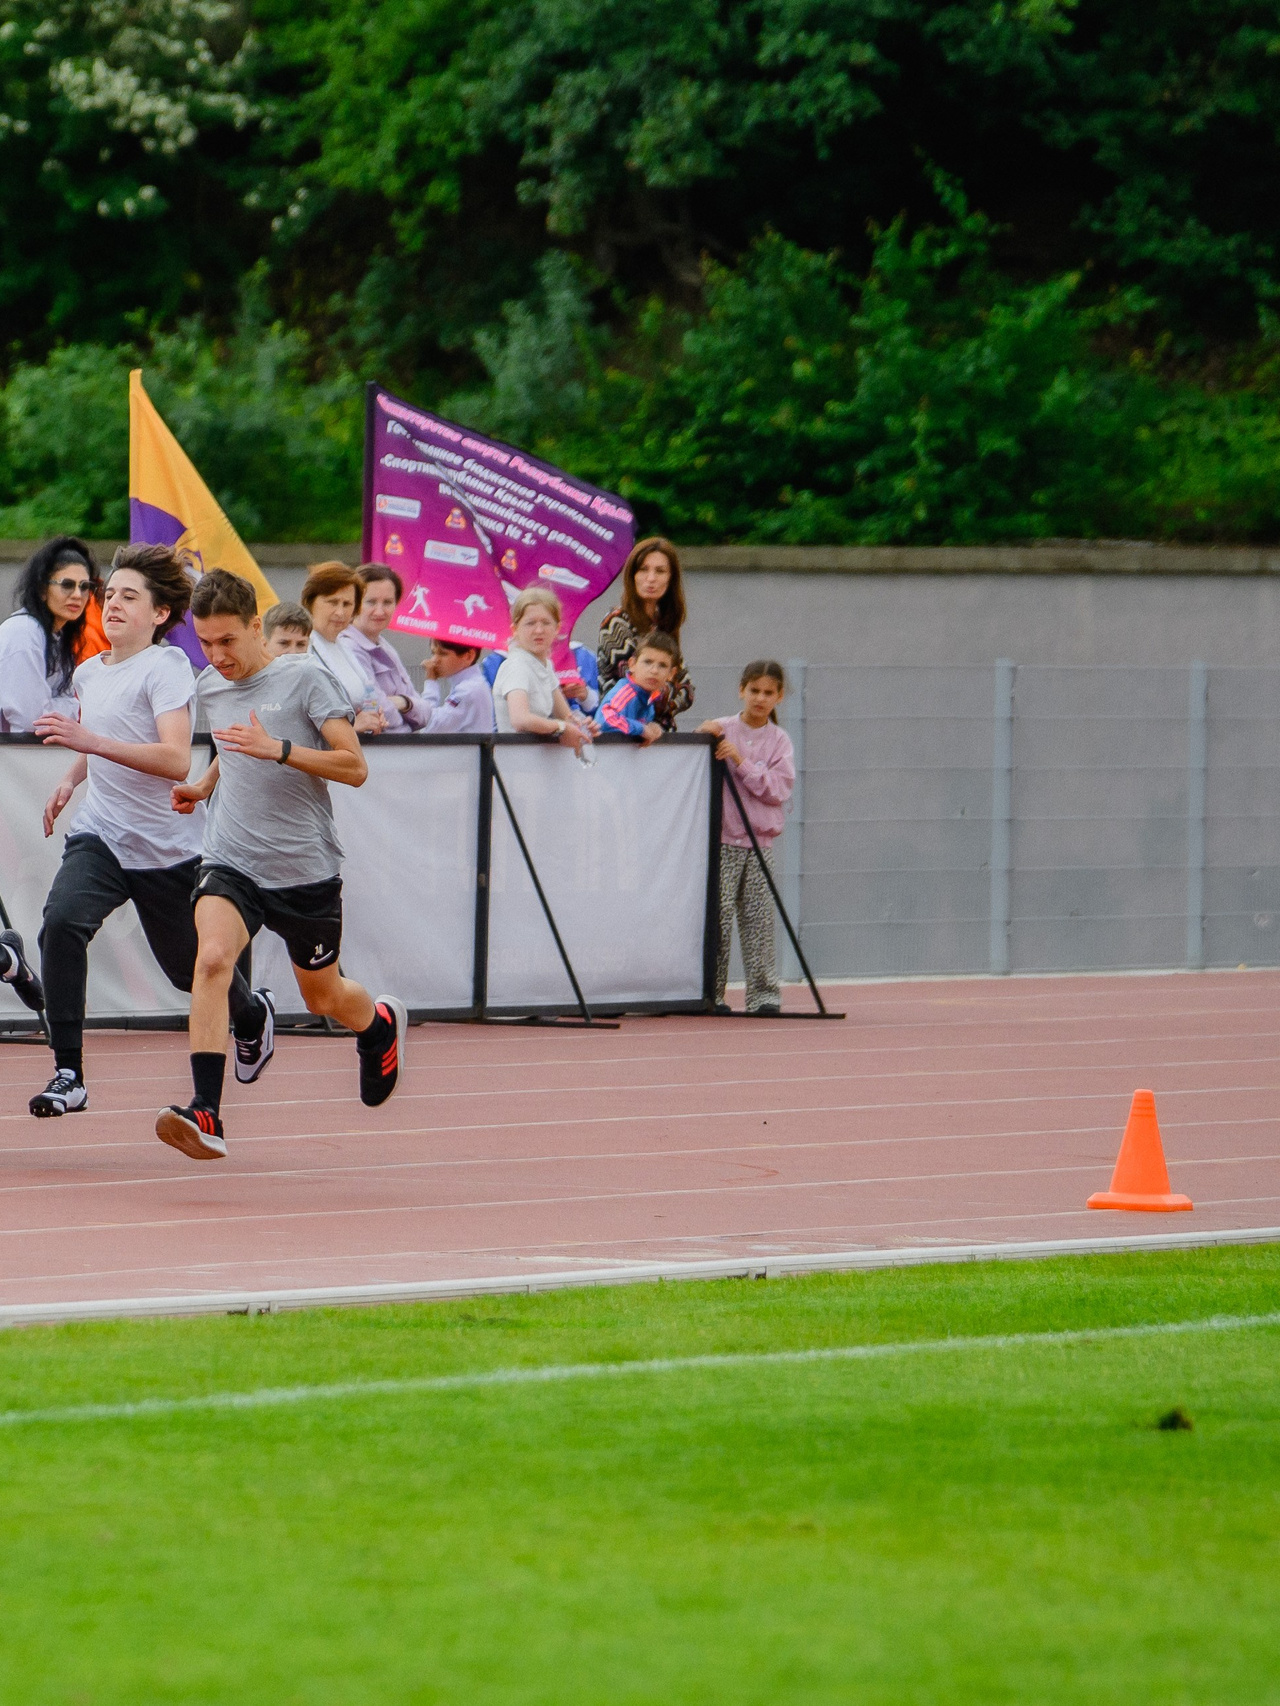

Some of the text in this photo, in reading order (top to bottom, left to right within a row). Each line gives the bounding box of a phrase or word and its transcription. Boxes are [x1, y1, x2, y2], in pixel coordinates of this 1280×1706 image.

[509, 456, 592, 506] Республики
[463, 458, 537, 499] бюджетное
[534, 493, 615, 541] учреждение
[494, 487, 536, 513] Крым
[547, 530, 603, 565] резерва
[396, 615, 496, 643] МЕТАНИЯ ПРЫЖКИ
[260, 702, 282, 712] FILA
